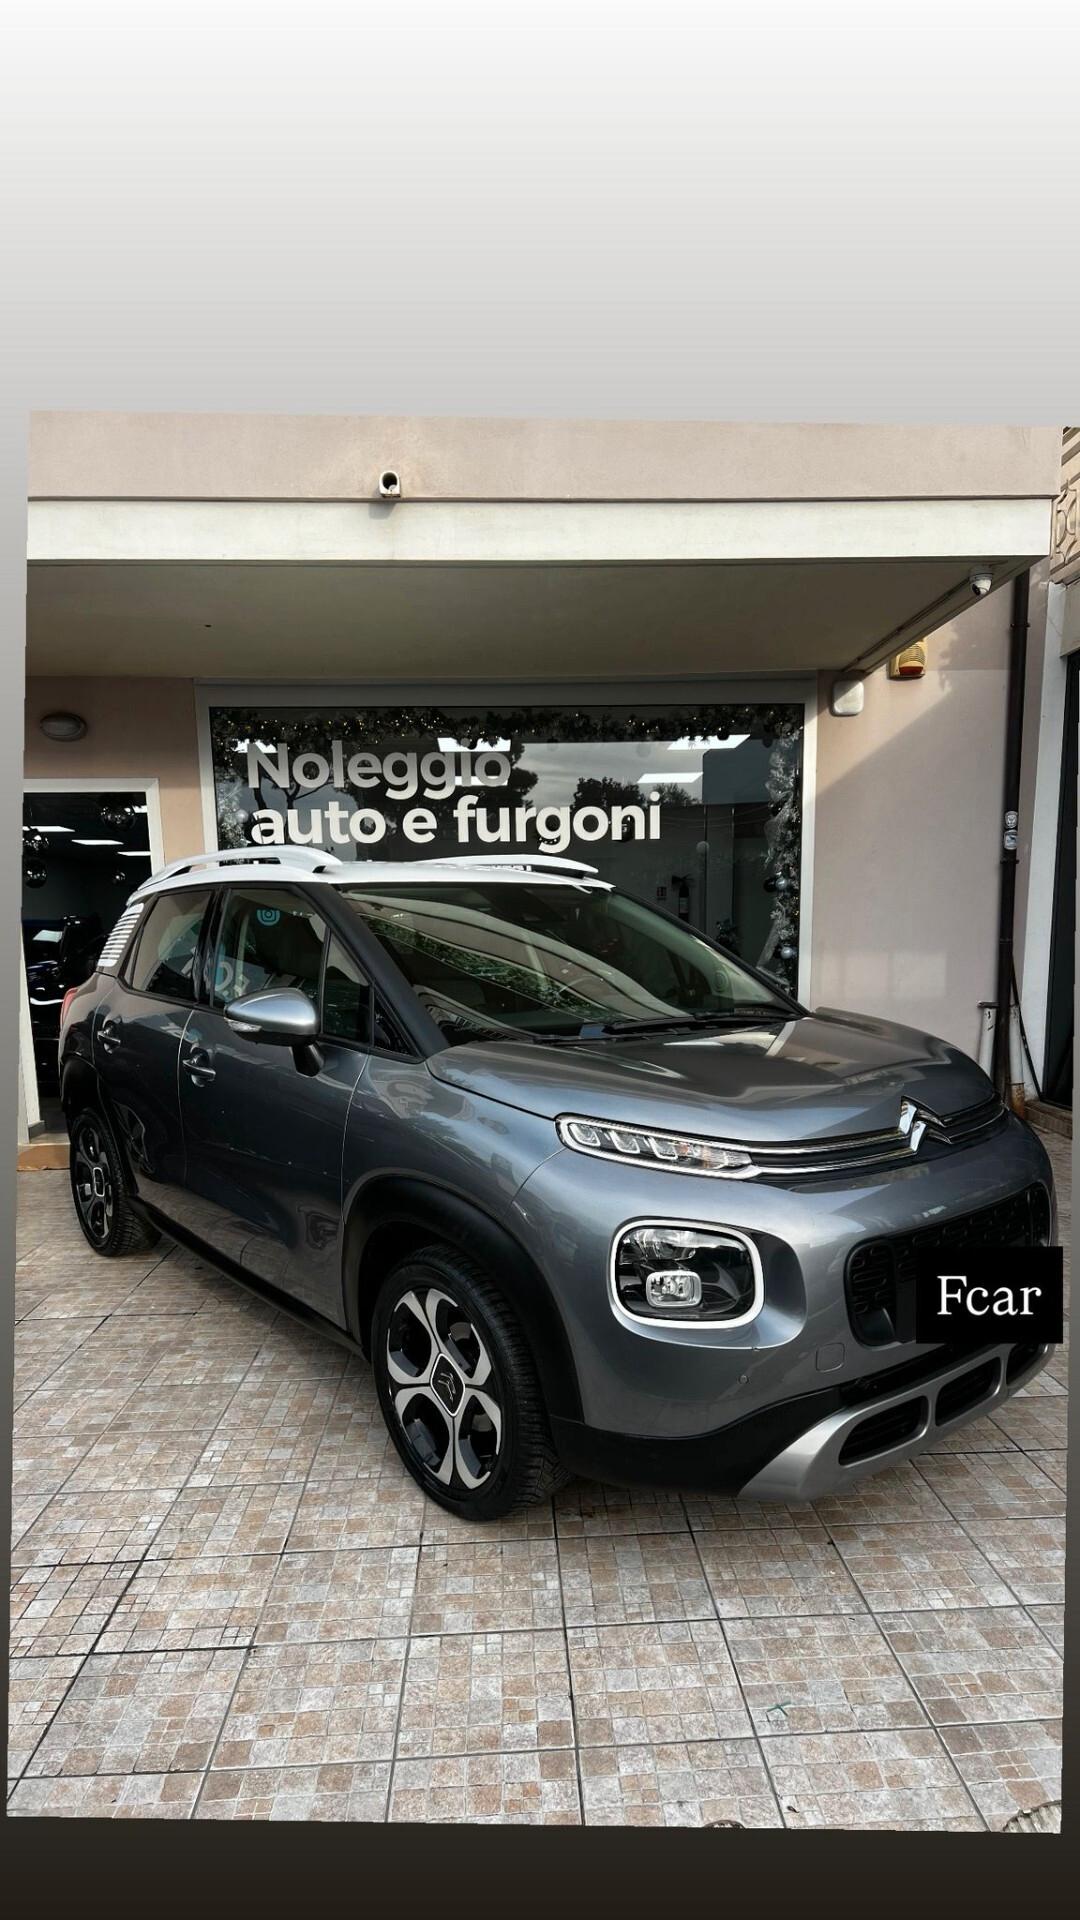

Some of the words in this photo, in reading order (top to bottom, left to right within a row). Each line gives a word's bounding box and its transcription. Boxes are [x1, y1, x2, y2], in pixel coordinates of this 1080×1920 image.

[247, 737, 512, 800] Noleggio
[251, 801, 387, 844] auto
[402, 807, 438, 844] e
[453, 791, 661, 854] furgoni
